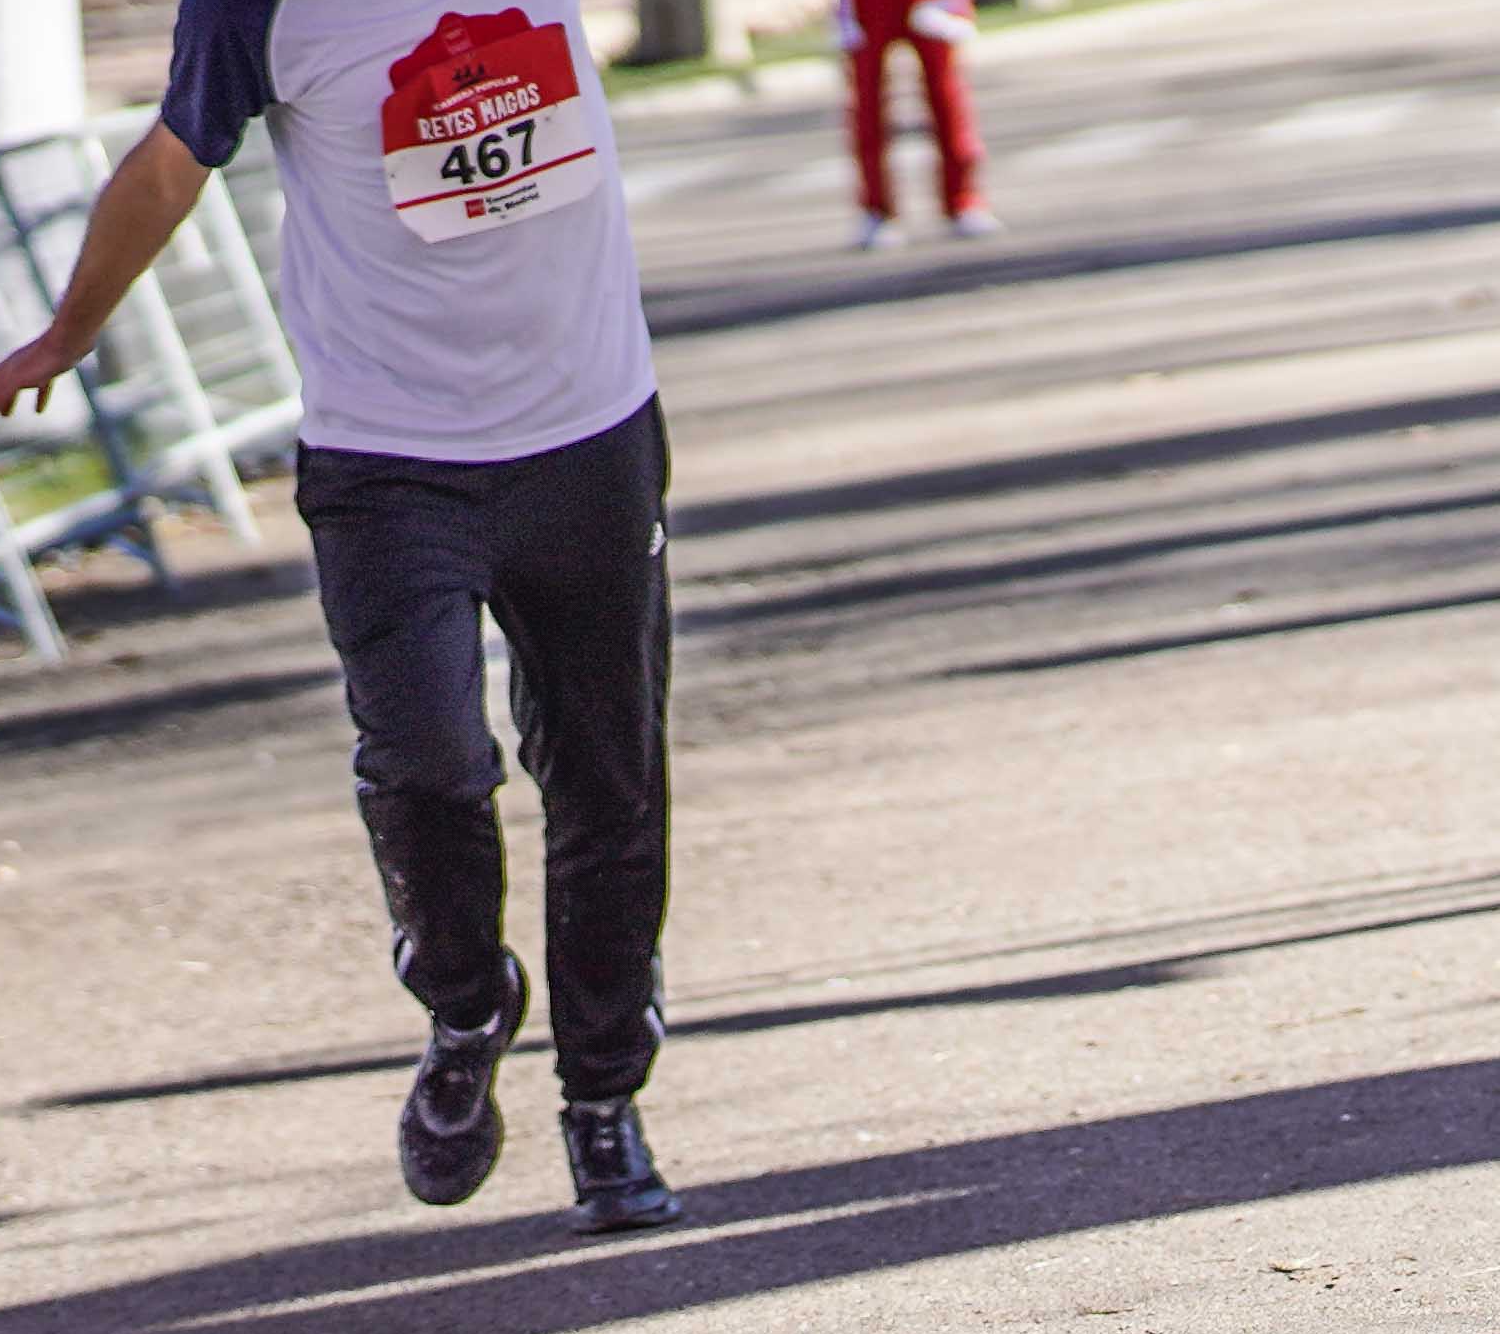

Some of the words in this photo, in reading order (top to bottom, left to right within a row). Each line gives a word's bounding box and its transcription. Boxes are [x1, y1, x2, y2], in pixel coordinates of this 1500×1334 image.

[417, 107, 477, 140] REYES
[478, 82, 540, 126] MAGOS
[441, 118, 536, 185] 467
